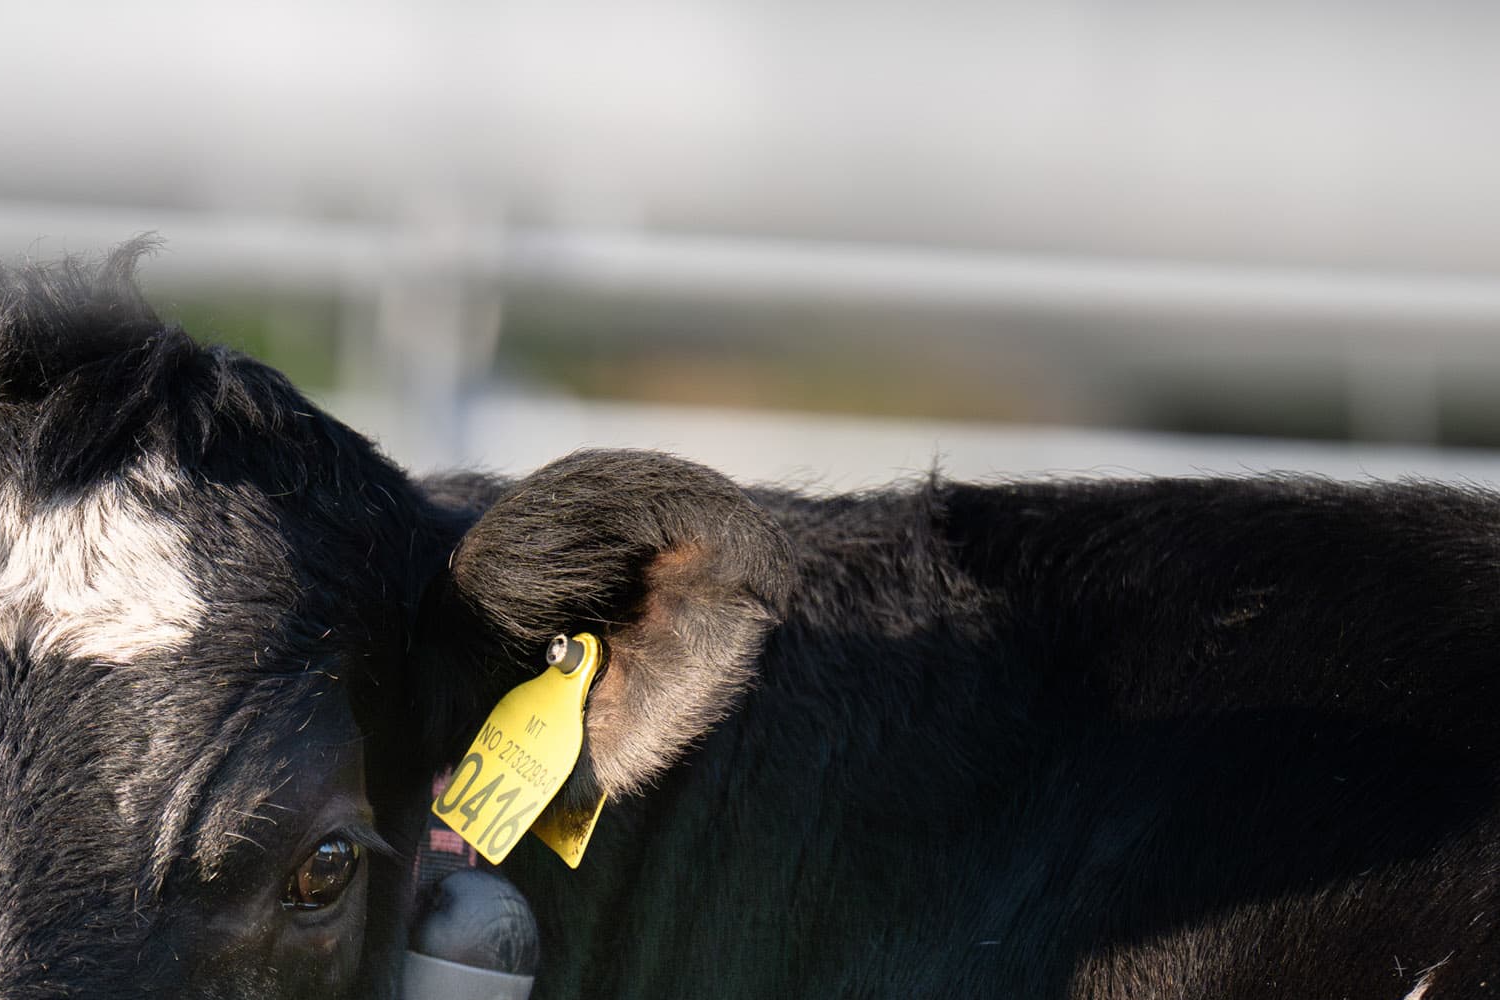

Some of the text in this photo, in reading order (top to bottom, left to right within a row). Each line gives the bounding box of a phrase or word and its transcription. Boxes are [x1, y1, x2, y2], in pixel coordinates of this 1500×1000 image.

[479, 722, 503, 751] NO
[526, 715, 547, 739] MT
[436, 752, 538, 856] 0416
